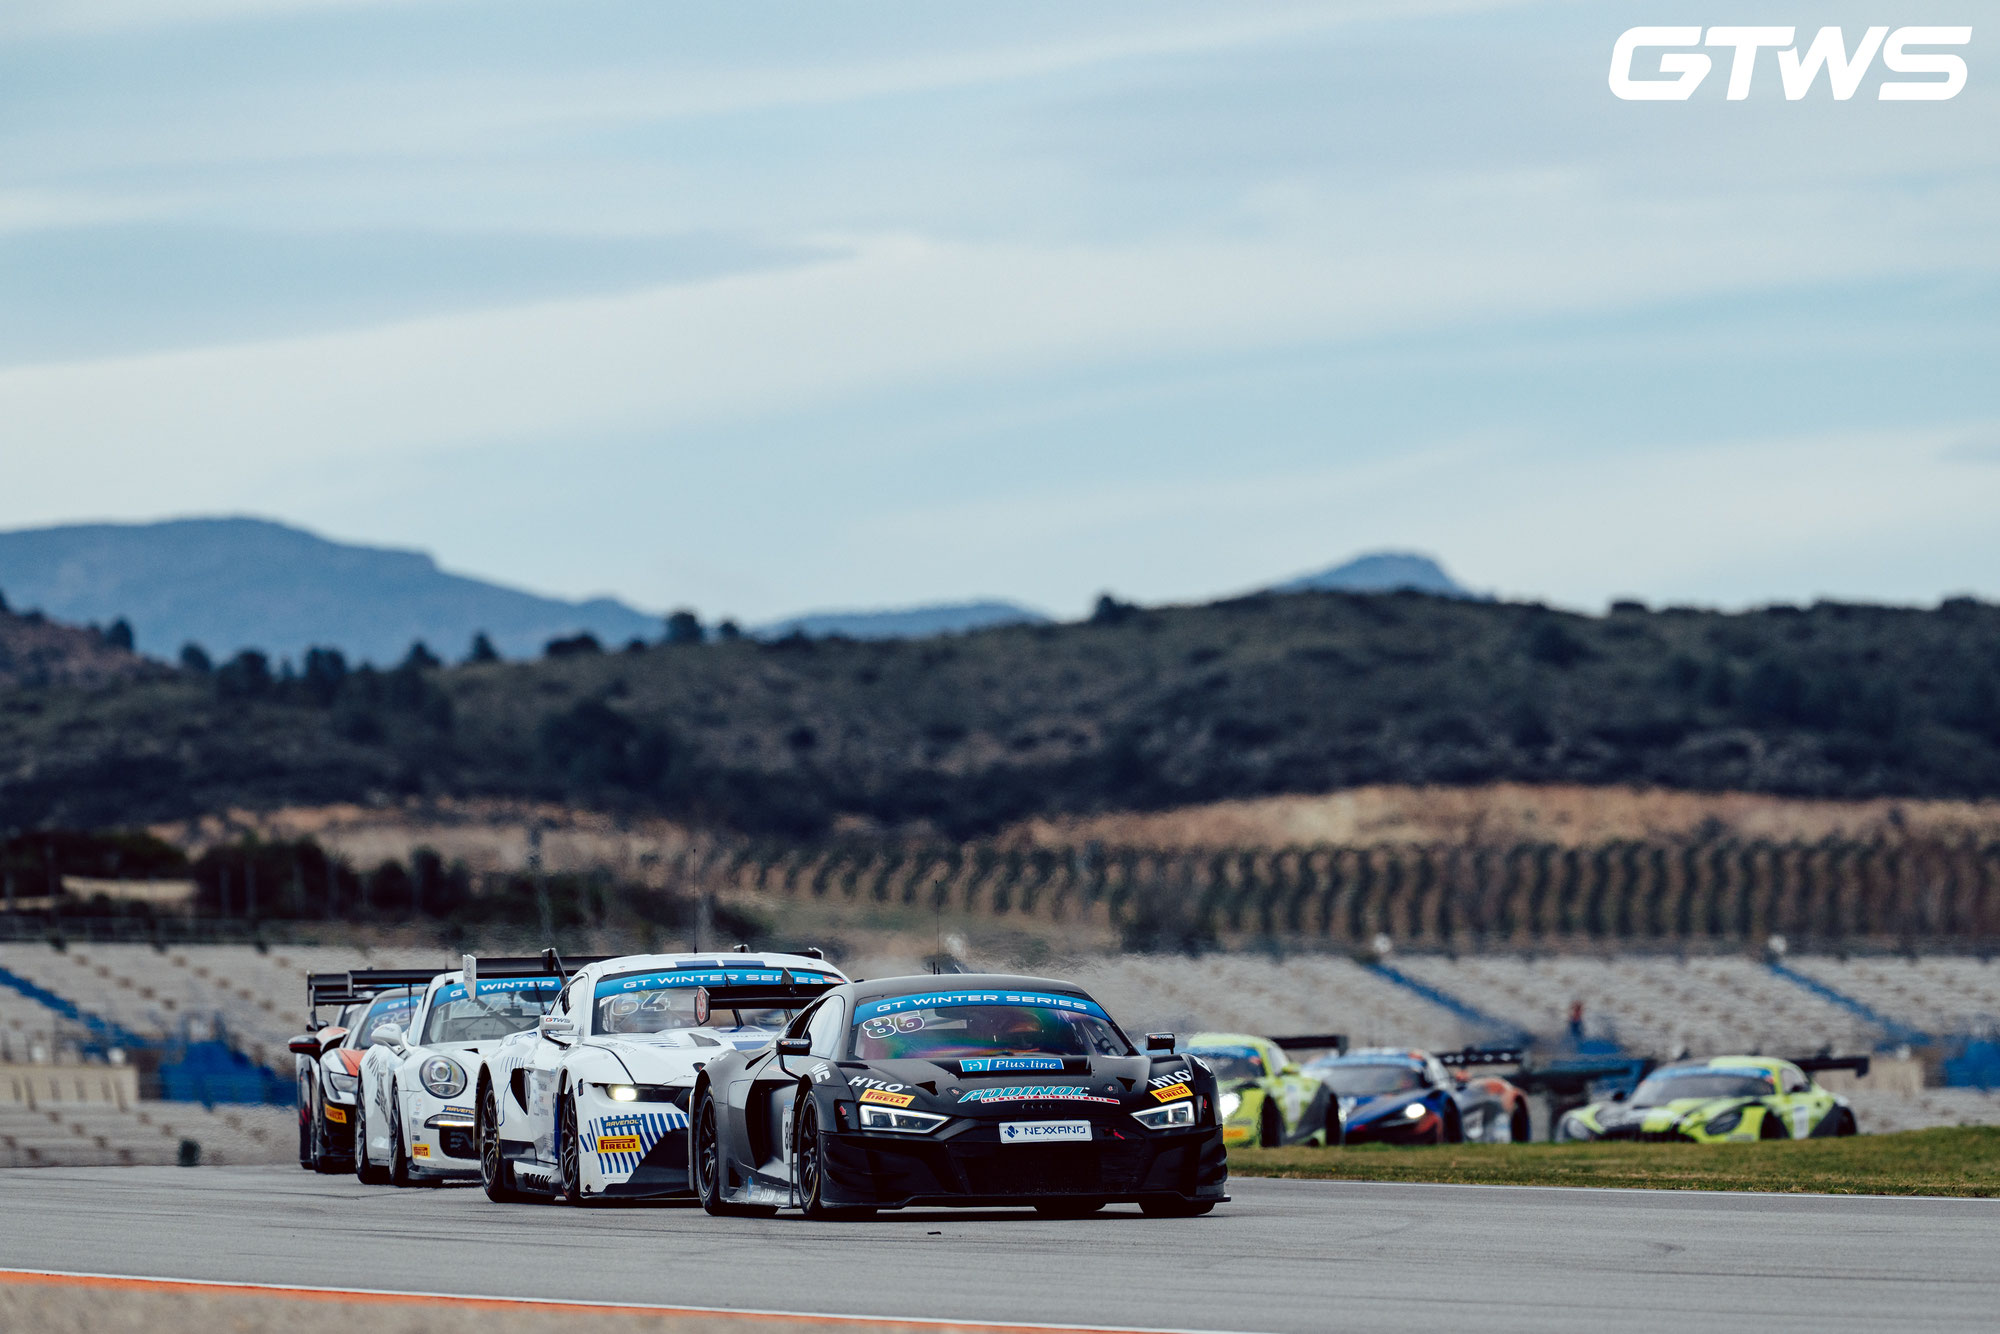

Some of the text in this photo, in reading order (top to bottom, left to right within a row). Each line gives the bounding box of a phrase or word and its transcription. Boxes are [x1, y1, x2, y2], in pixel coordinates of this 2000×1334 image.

[481, 981, 555, 991] WINTER
[624, 979, 651, 989] GT
[658, 974, 738, 984] WINTER
[746, 974, 823, 984] SEES
[611, 991, 671, 1016] 64
[877, 995, 1087, 1012] GT WINTER SERIES
[862, 1010, 925, 1039] 86
[996, 1061, 1057, 1069] Plus.line
[865, 1091, 909, 1104] PIRELLI
[958, 1086, 1089, 1104] ADDINOL
[1156, 1086, 1187, 1099] PIRELLI
[606, 1119, 639, 1127] RAVENOL
[600, 1139, 636, 1150] PIRELLI
